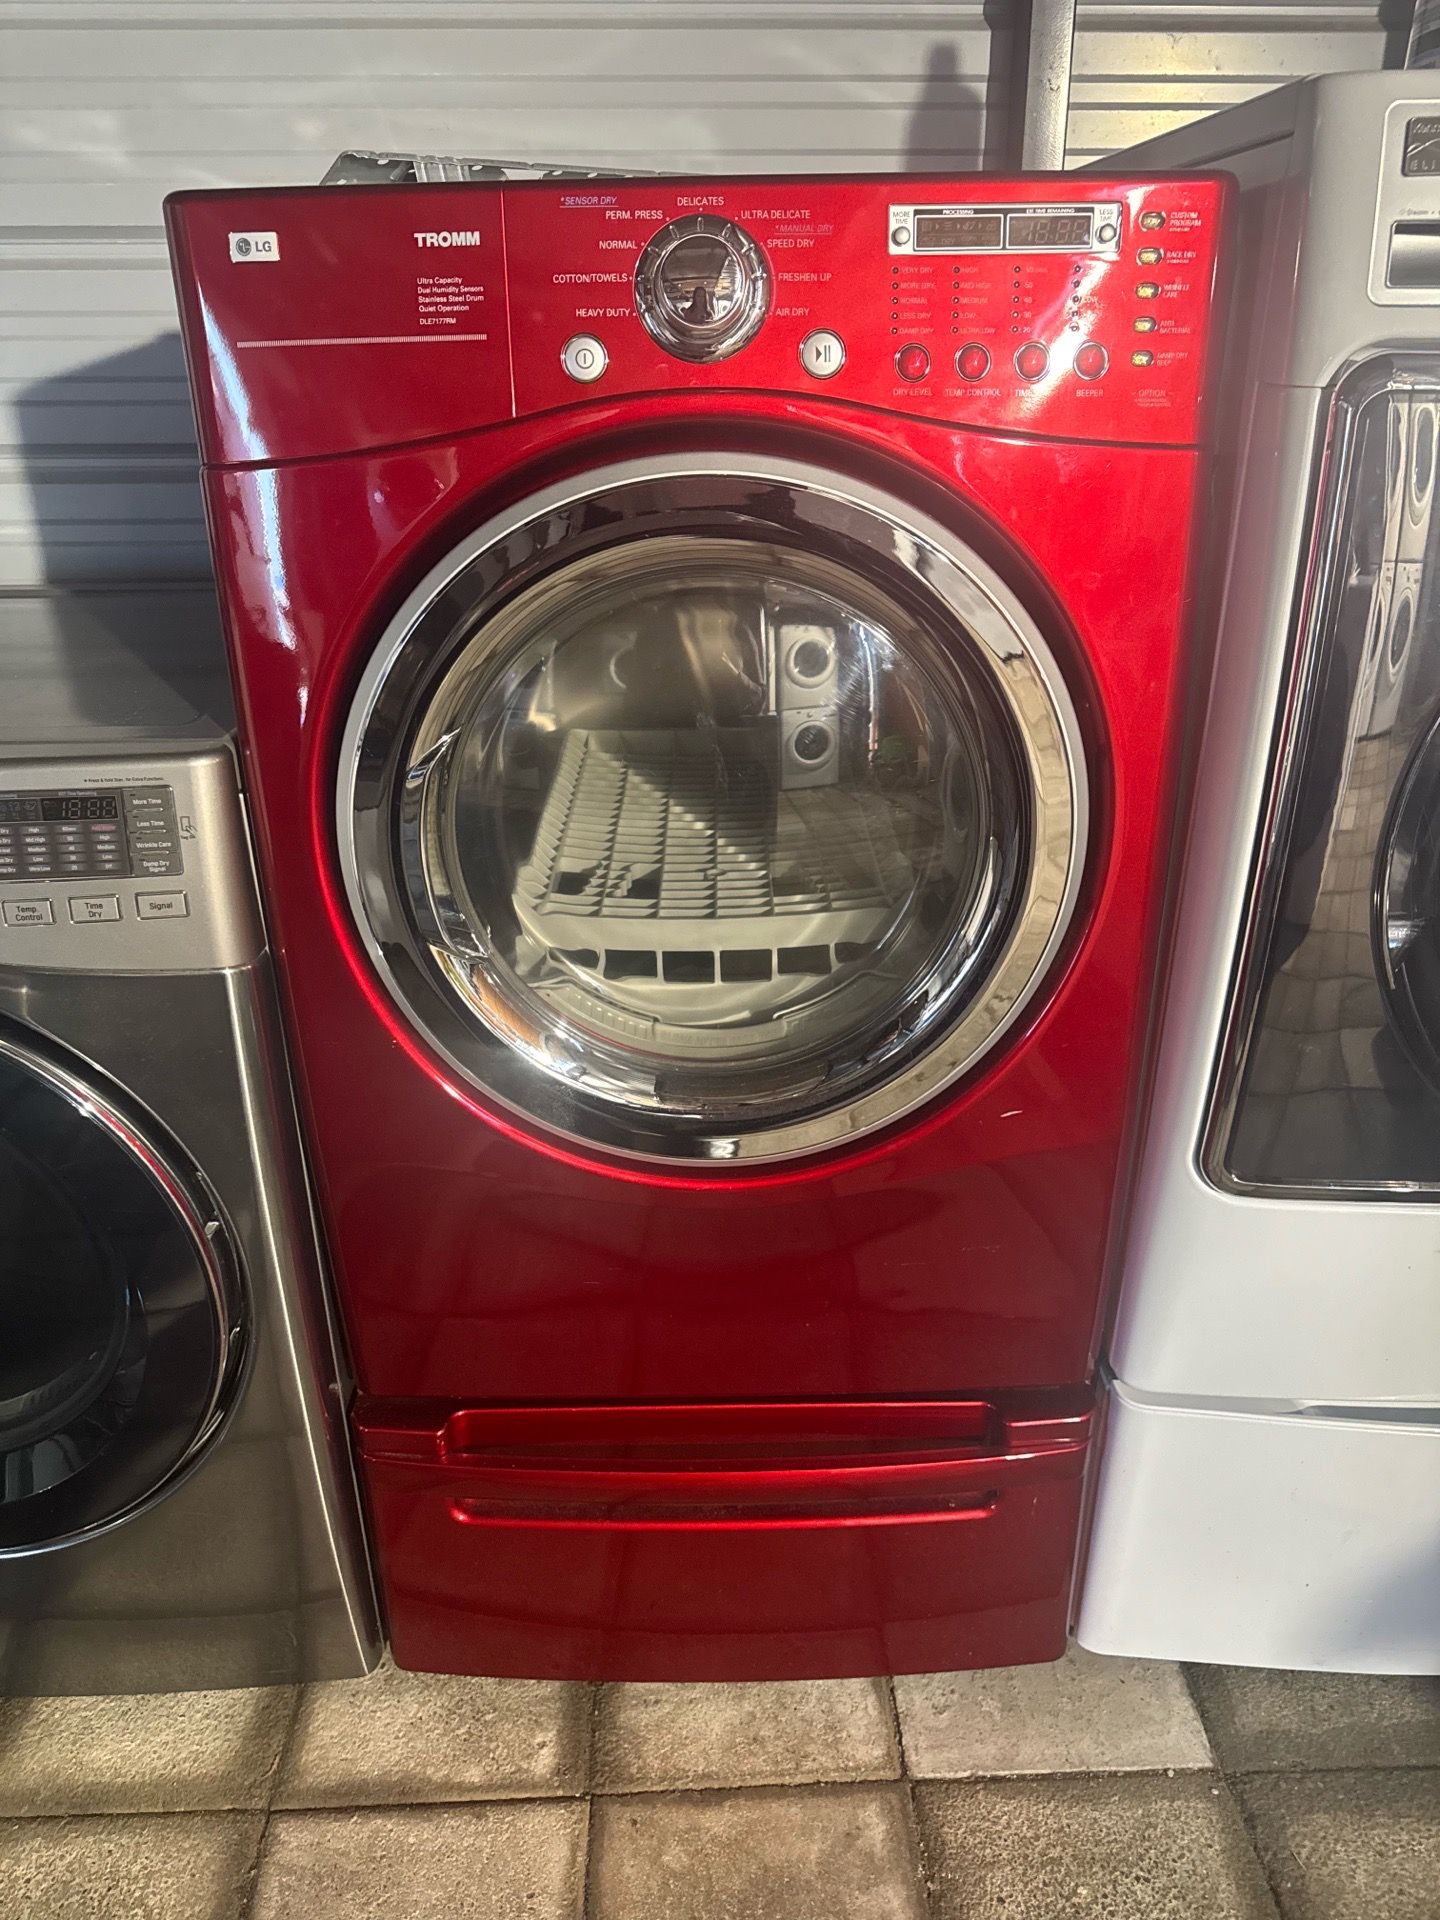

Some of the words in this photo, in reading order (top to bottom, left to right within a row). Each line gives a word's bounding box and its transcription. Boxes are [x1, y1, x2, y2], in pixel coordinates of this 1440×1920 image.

[600, 196, 618, 205] DRY
[677, 196, 725, 207] DELICATES
[605, 210, 633, 220] PERM.
[634, 209, 663, 219] PRESS
[740, 209, 769, 219] ULTRA
[771, 209, 811, 219] DELICATE
[892, 210, 911, 218] MORE
[1100, 208, 1114, 216] LESS
[1170, 211, 1199, 219] CUSTOM
[1169, 219, 1202, 227] PROGRAM
[817, 224, 834, 233] DRY
[414, 231, 481, 247] TROMM
[767, 239, 795, 248] SPEED
[796, 239, 815, 248] DRY
[254, 241, 273, 253] LG
[599, 240, 638, 250] NORMAL
[900, 266, 918, 274] VERY
[919, 266, 933, 274] DRY
[434, 276, 463, 285] Capacity
[552, 273, 628, 283] COTTON/TOWELS
[778, 272, 818, 282] FRESHEN
[820, 272, 832, 281] UP
[417, 286, 431, 294] Dual
[432, 286, 459, 294] Humidity
[460, 285, 484, 293] Sensors
[900, 282, 919, 290] MORE
[418, 295, 447, 303] Stainless
[465, 294, 485, 302] Drum
[900, 297, 928, 305] NORMAL
[437, 304, 470, 313] Operation
[575, 308, 605, 318] HEAVY
[606, 308, 631, 317] DUTY
[776, 307, 791, 317] AIR
[791, 307, 810, 317] DRY
[900, 311, 917, 319] LESS
[917, 311, 932, 319] DRY
[960, 311, 977, 319] LOW
[419, 317, 457, 325] DLE7177RM
[1160, 319, 1175, 327] ANTI
[899, 328, 919, 336] DAMP
[1159, 326, 1191, 334] BACTERIAL
[1176, 351, 1189, 359] DRY
[892, 387, 908, 397] DRY
[909, 387, 933, 396] LEVEL
[944, 388, 966, 397] TEMP
[967, 388, 1001, 397] CONTROL
[1075, 388, 1105, 398] BEEPER
[1138, 389, 1167, 397] OPTION
[159, 860, 170, 868] Dry
[84, 902, 104, 910] Time
[149, 902, 173, 911] Signal
[15, 913, 43, 922] Control
[88, 911, 102, 919] Dry
